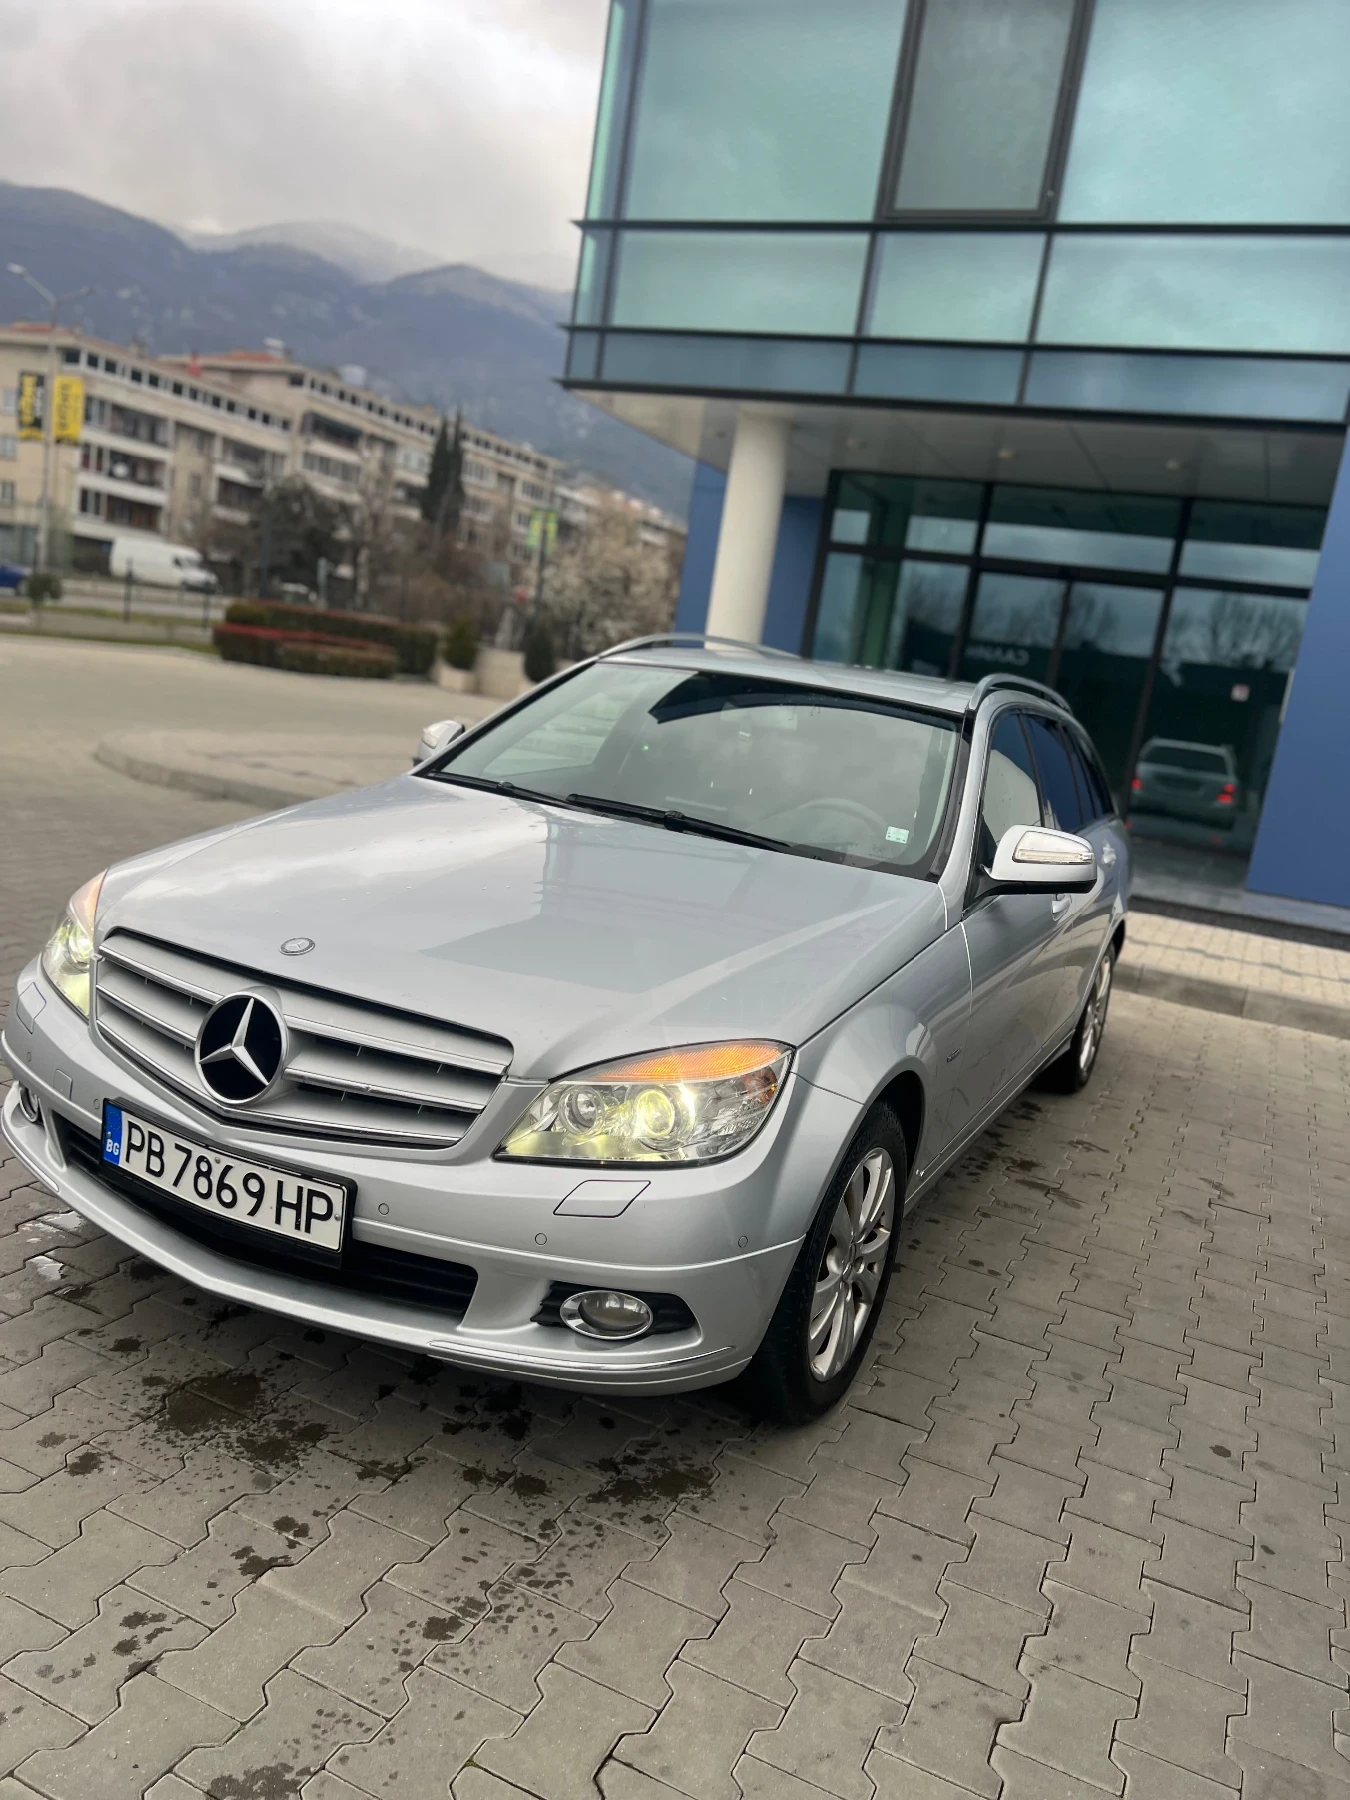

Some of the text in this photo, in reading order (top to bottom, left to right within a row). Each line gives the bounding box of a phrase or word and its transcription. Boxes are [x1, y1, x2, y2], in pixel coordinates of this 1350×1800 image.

[105, 1138, 120, 1156] BG
[125, 1120, 334, 1234] PB 7869 HP
